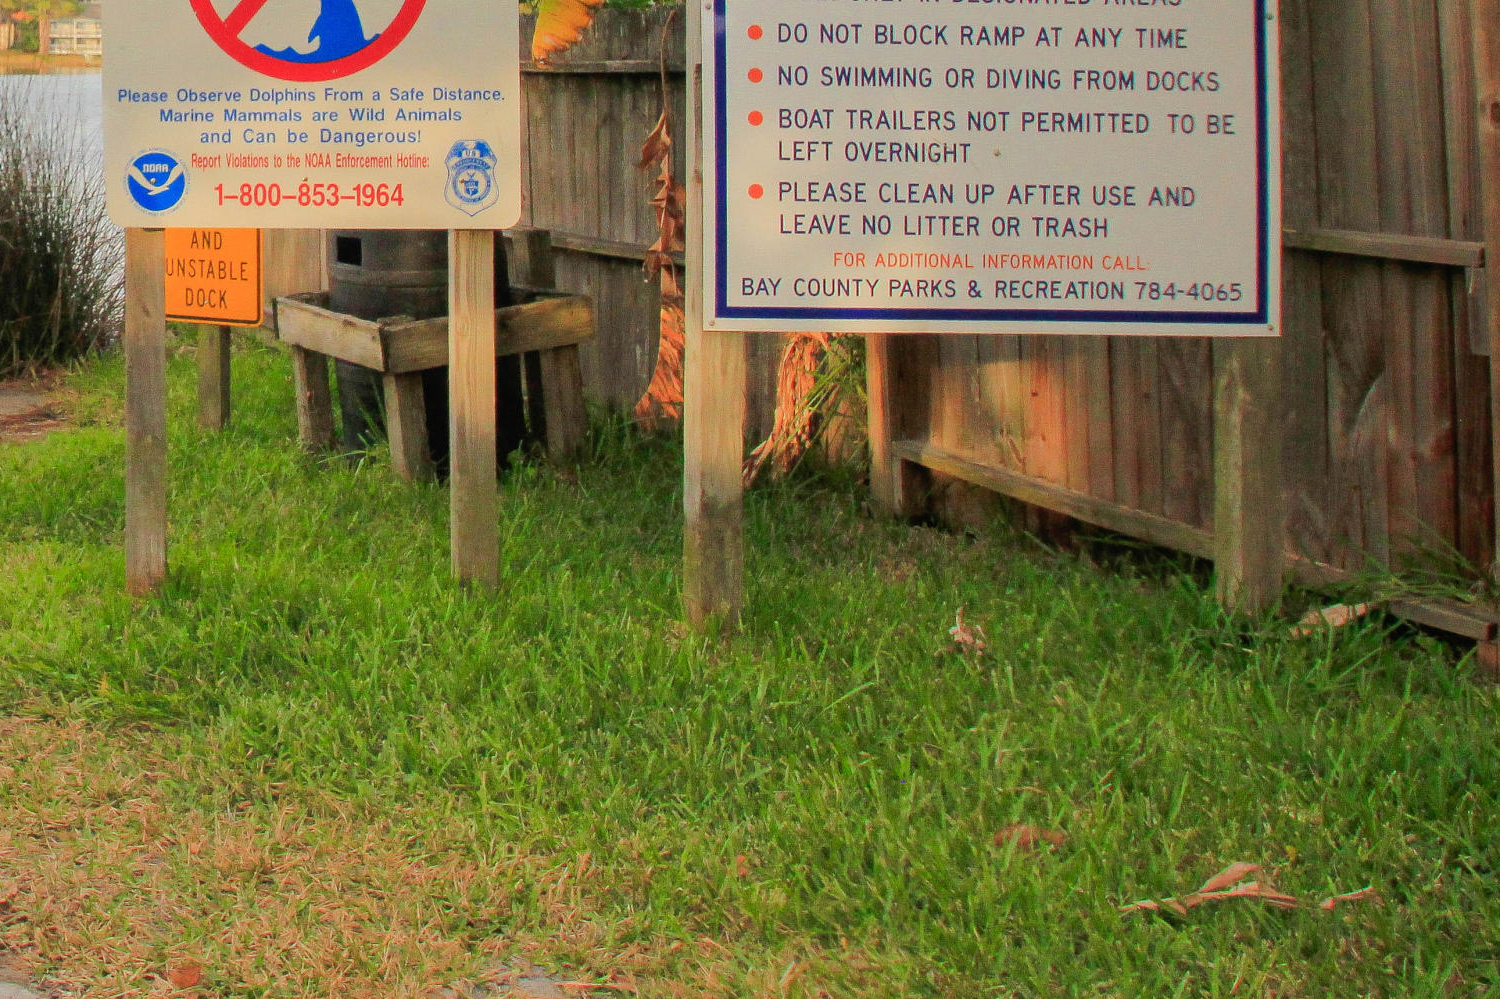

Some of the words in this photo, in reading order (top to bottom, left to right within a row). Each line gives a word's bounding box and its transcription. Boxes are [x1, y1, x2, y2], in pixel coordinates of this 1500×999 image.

[778, 23, 808, 44] DO
[820, 24, 863, 45] NOT
[874, 24, 947, 46] BLOCK
[960, 25, 1024, 47] RAMP
[1035, 26, 1062, 47] AT
[1075, 27, 1123, 48] ANY
[1136, 28, 1188, 49] TIME
[778, 67, 808, 87] NO
[820, 66, 932, 88] SWIMMING
[945, 68, 975, 89] OR
[987, 69, 1061, 90] DIVING
[1073, 70, 1134, 91] FROM
[1146, 71, 1220, 92] DOCKS
[118, 89, 168, 103] Please
[177, 88, 241, 102] Observe
[250, 88, 316, 104] Dolphins
[324, 88, 363, 101] From
[372, 91, 380, 101] a
[390, 87, 424, 101] Safe
[433, 87, 505, 101] Distance.
[160, 109, 214, 122] Marine
[224, 109, 301, 121] Mammals
[312, 111, 338, 121] are
[349, 108, 385, 121] Wild
[395, 107, 462, 120] Animals
[779, 109, 835, 130] BOAT
[846, 110, 956, 132] TRAILERS
[968, 111, 1010, 132] NOT
[1021, 112, 1150, 134] PERMITTED
[1167, 114, 1194, 135] TO
[1207, 114, 1235, 135] BE
[200, 130, 231, 143] and
[243, 129, 276, 143] Can
[287, 129, 308, 143] be
[320, 129, 421, 146] Dangerous!
[191, 154, 221, 170] Report
[226, 153, 269, 168] Violations
[273, 156, 283, 168] to
[287, 154, 300, 167] the
[305, 153, 331, 168] NOAA
[336, 153, 393, 168] Enforcement
[397, 153, 429, 168] Hotline:
[779, 141, 834, 162] LEFT
[845, 141, 971, 164] OVERNIGHT
[779, 182, 867, 203] PLEASE
[879, 182, 954, 204] CLEAN
[966, 183, 996, 205] UP
[1007, 184, 1081, 206] AFTER
[1092, 186, 1136, 207] USE
[1148, 186, 1194, 208] AND
[779, 214, 851, 235] LEAVE
[862, 215, 892, 236] NO
[904, 215, 979, 237] LITTER
[991, 216, 1021, 238] OR
[1032, 217, 1108, 238] TRASH
[191, 230, 222, 250] AND
[166, 258, 248, 280] UNSTABLE
[834, 252, 866, 267] FOR
[874, 252, 975, 269] ADDITIONAL
[982, 254, 1093, 270] INFORMATION
[185, 288, 227, 309] DOCK
[742, 277, 781, 297] BAY
[793, 277, 878, 298] COUNTY
[889, 279, 956, 299] PARKS
[968, 279, 983, 299] &
[995, 279, 1124, 301] RECREATION
[1134, 282, 1242, 302] 784-4065
